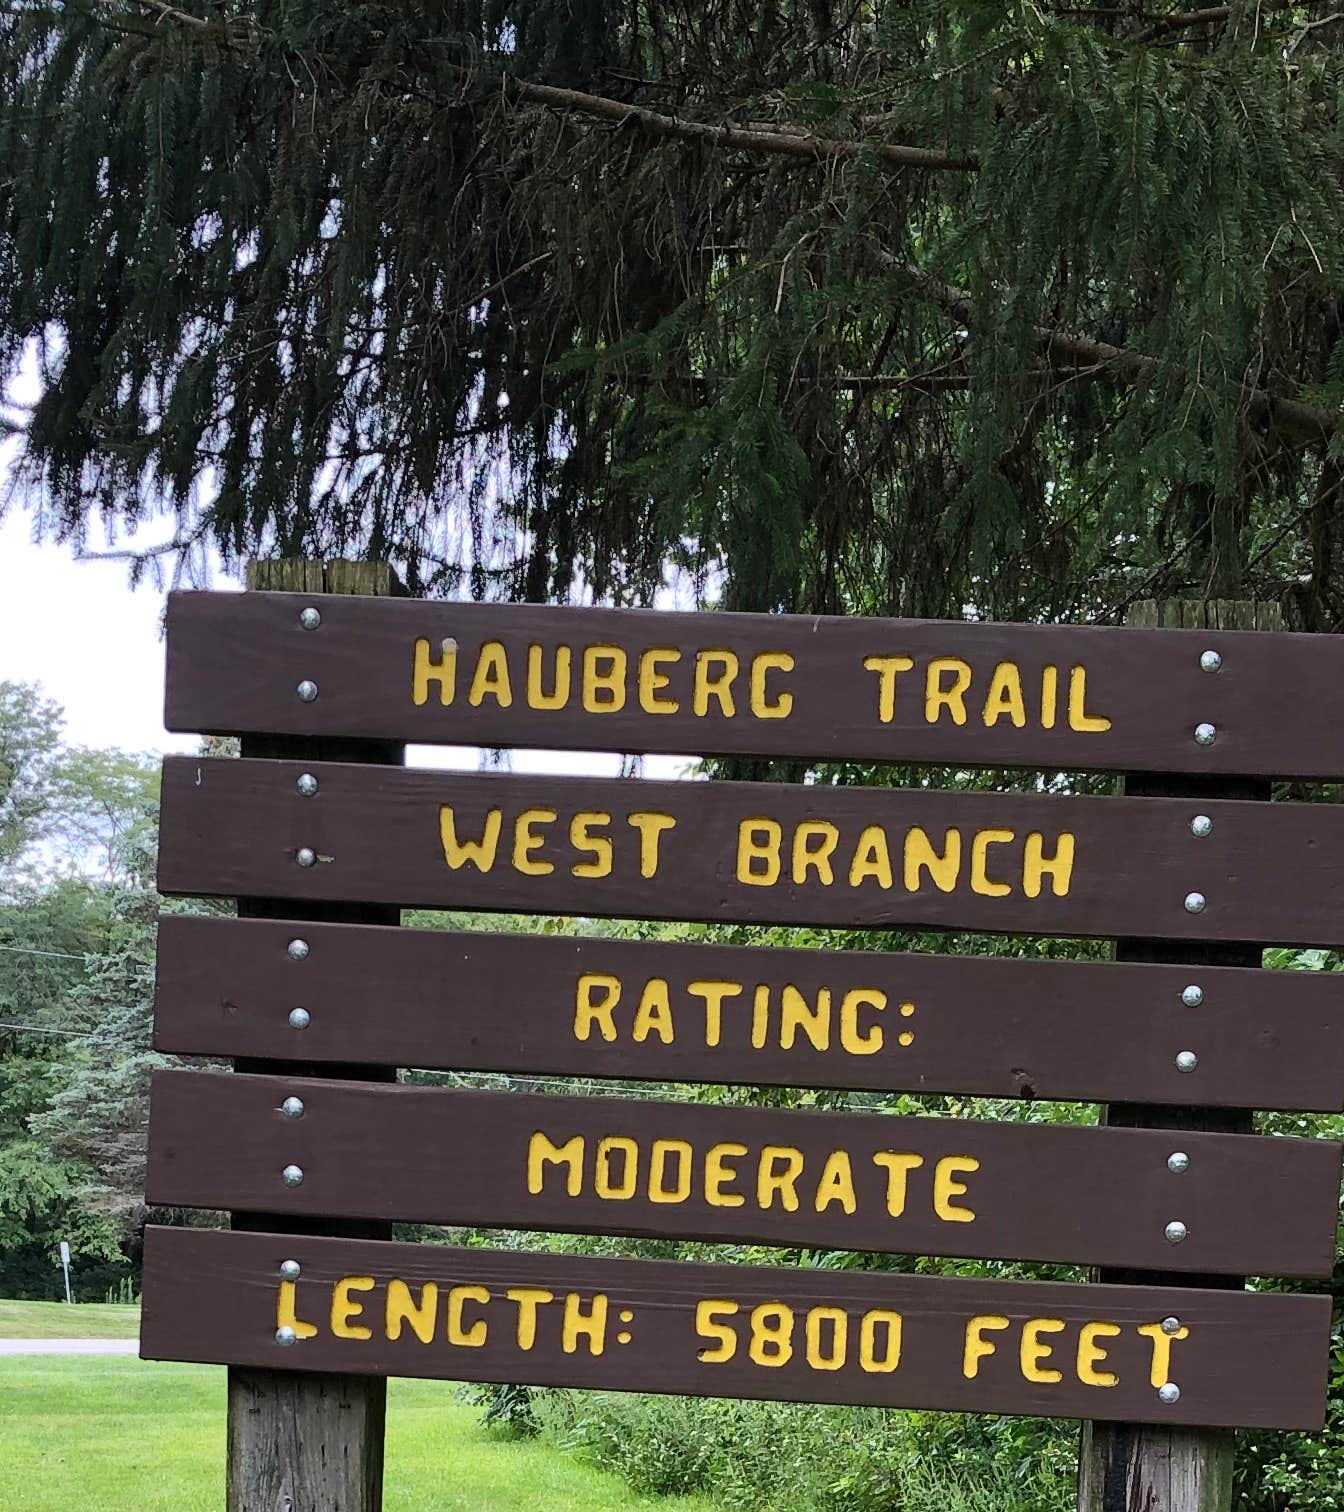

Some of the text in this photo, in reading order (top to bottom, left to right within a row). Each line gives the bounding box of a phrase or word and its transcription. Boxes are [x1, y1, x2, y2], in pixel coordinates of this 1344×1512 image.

[412, 638, 1111, 733] HAUBERG TRAIL
[438, 806, 1076, 899] WEST BRANCH
[572, 974, 917, 1056] RATING:
[526, 1131, 981, 1224] MODERATE
[276, 1278, 1190, 1390] LENGTH: 5800 FEET
